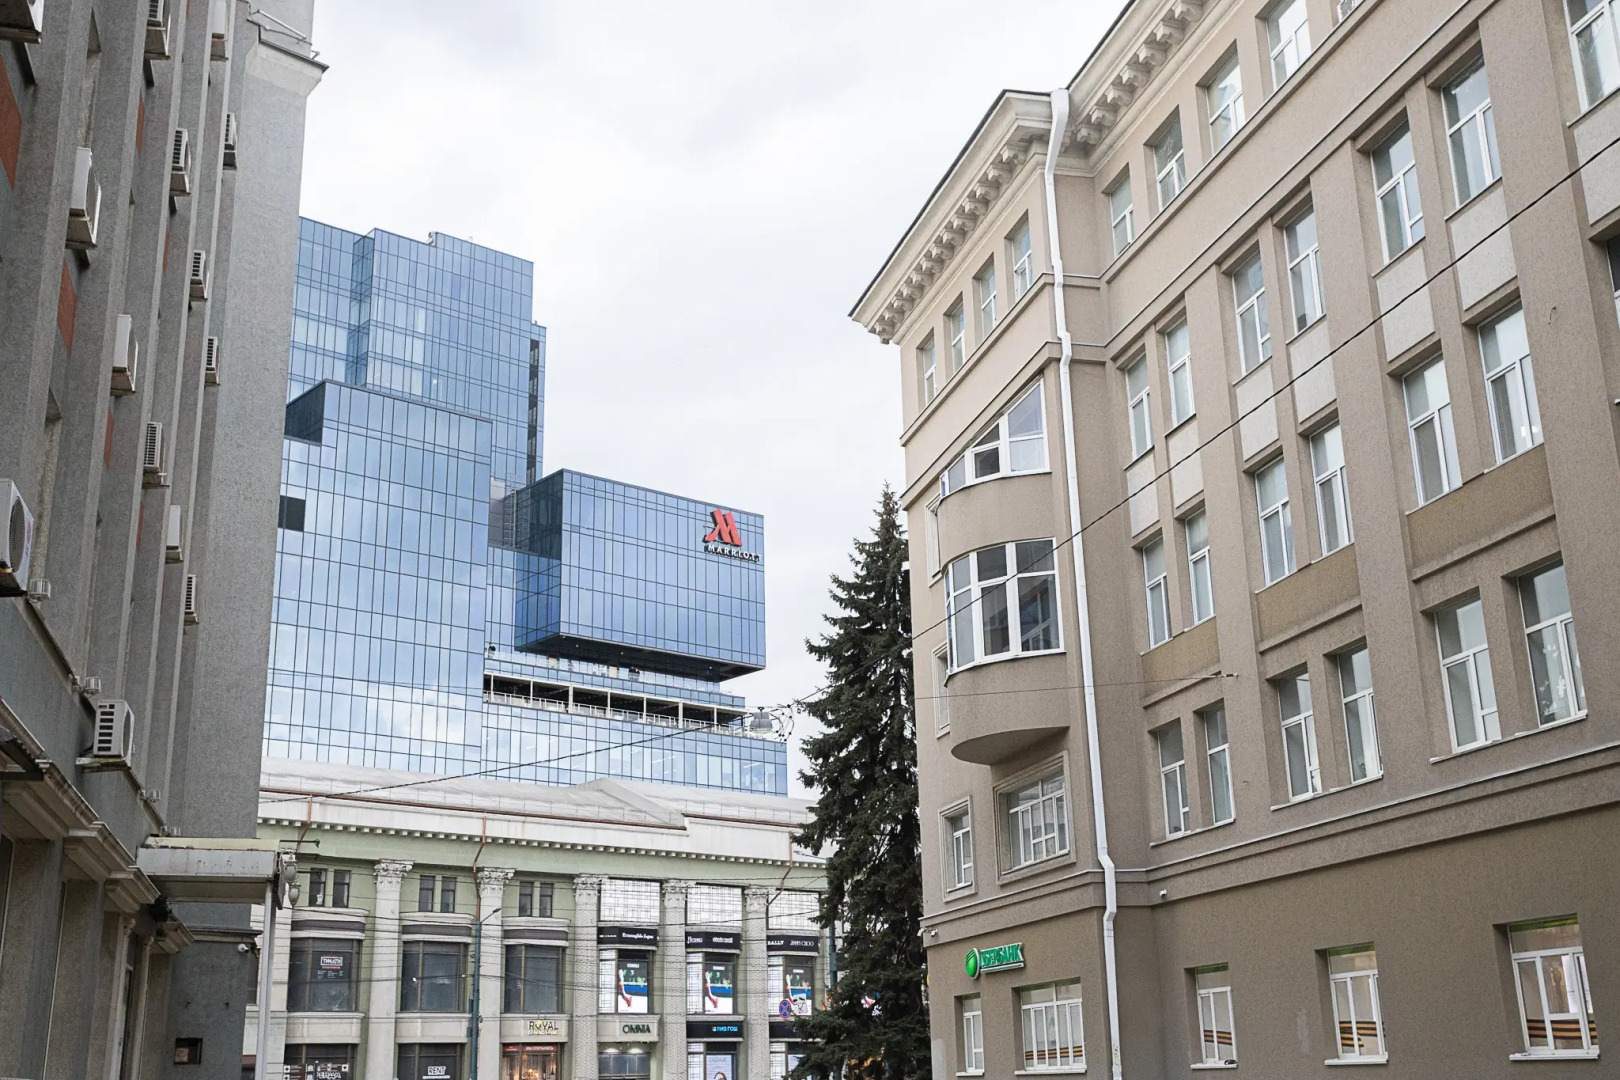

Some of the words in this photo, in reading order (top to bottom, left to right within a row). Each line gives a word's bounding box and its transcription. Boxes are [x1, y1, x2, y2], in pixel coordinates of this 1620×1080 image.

[706, 543, 762, 562] MARRIOTT
[979, 943, 1021, 968] СБЕРБАНК
[528, 1020, 559, 1030] ROYAL
[622, 1024, 651, 1034] OMNIA
[427, 1066, 447, 1075] RENT
